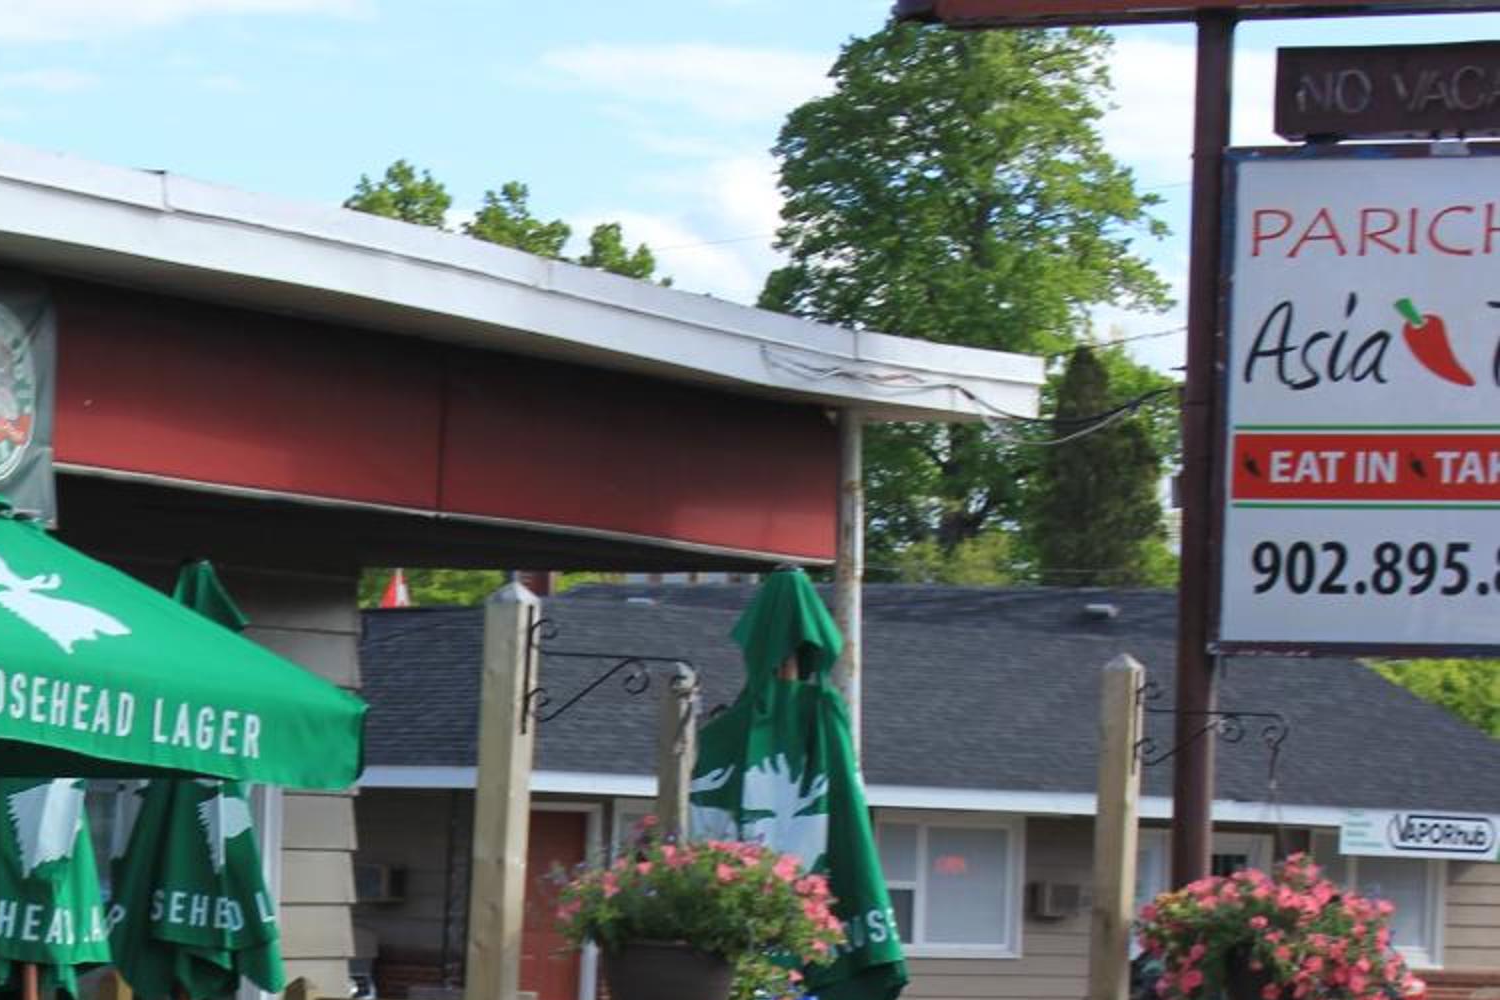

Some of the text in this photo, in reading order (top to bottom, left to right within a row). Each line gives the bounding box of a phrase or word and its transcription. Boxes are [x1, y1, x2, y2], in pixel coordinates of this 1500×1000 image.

[1295, 66, 1373, 114] NO
[1243, 292, 1393, 391] Asia
[1269, 451, 1345, 485] EAT
[1355, 451, 1398, 485] IN
[1251, 541, 1500, 597] 902.895.
[153, 697, 262, 759] LAGER
